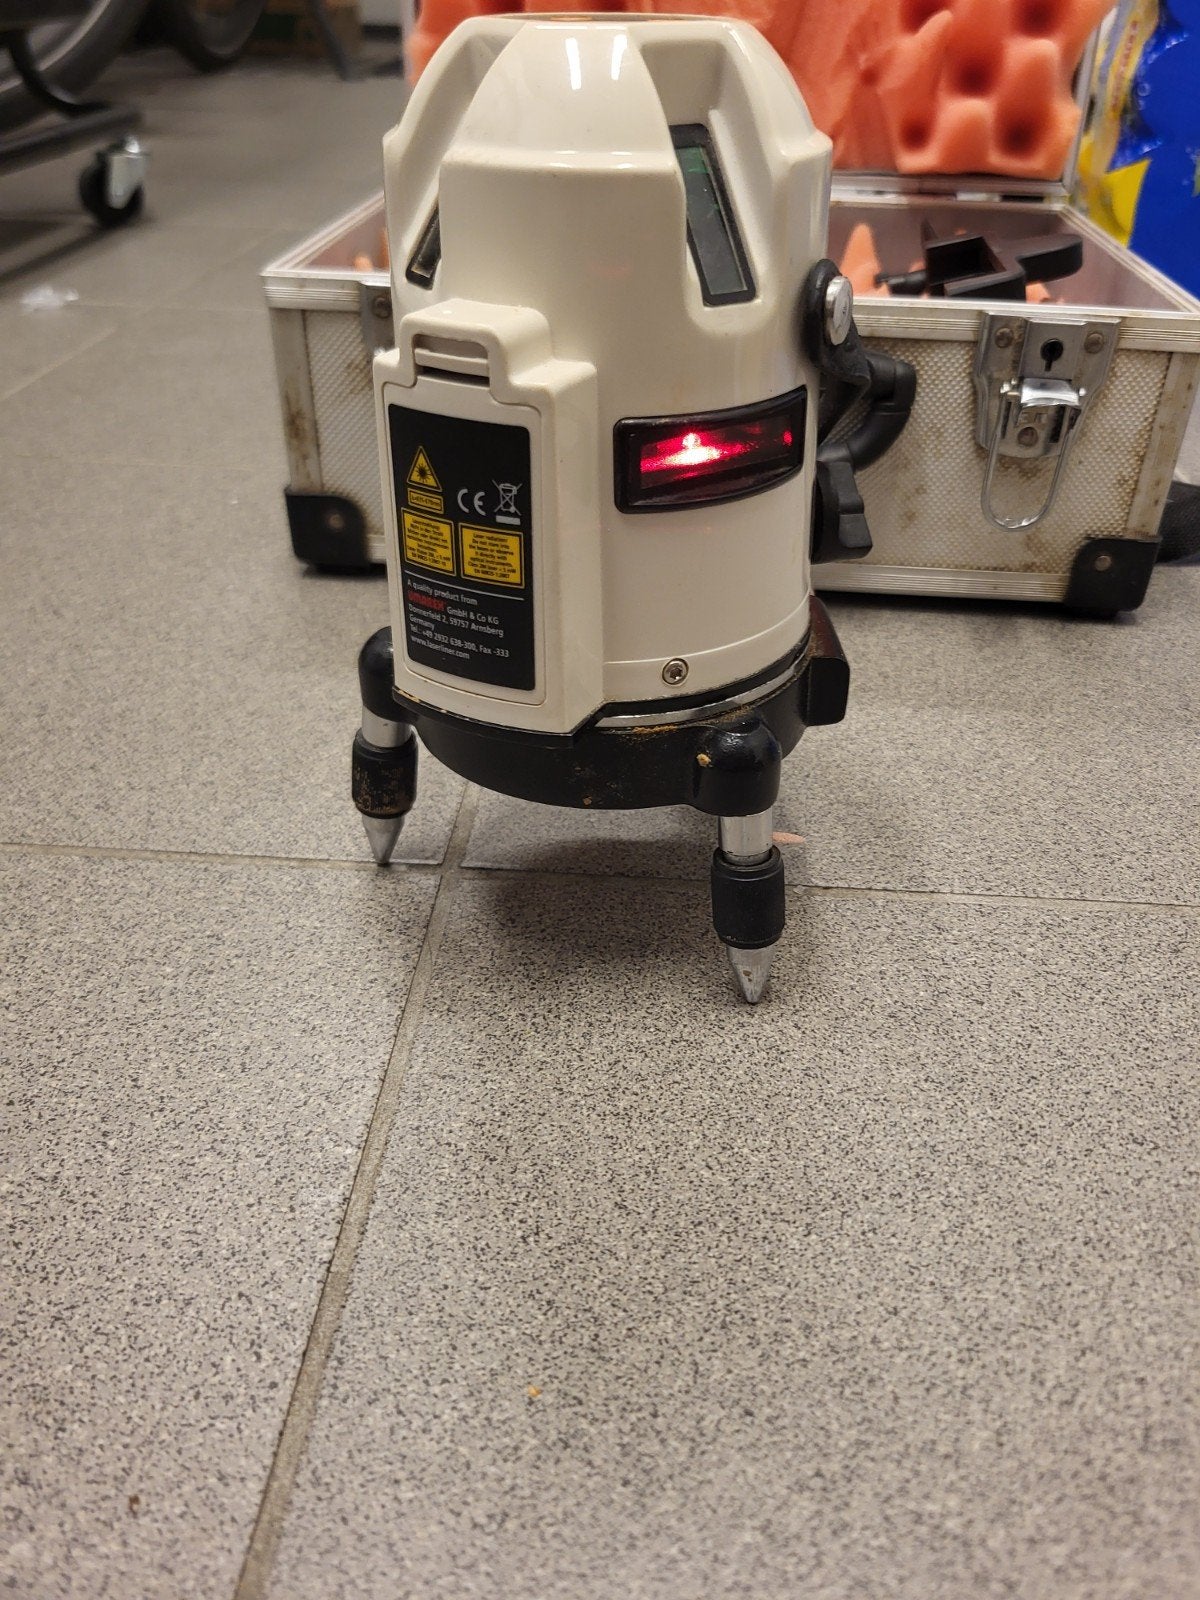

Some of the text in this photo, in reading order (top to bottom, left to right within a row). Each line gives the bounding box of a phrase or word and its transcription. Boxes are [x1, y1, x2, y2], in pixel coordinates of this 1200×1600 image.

[413, 582, 433, 595] quality
[434, 590, 459, 601] product
[461, 594, 477, 605] from
[409, 614, 434, 630] Germany
[446, 606, 467, 617] GmbH
[476, 613, 486, 622] Co
[488, 616, 499, 625] KG
[449, 618, 468, 629] 59757
[470, 622, 504, 638] Arnsberg
[479, 644, 492, 655] Fax
[493, 648, 510, 657] -333
